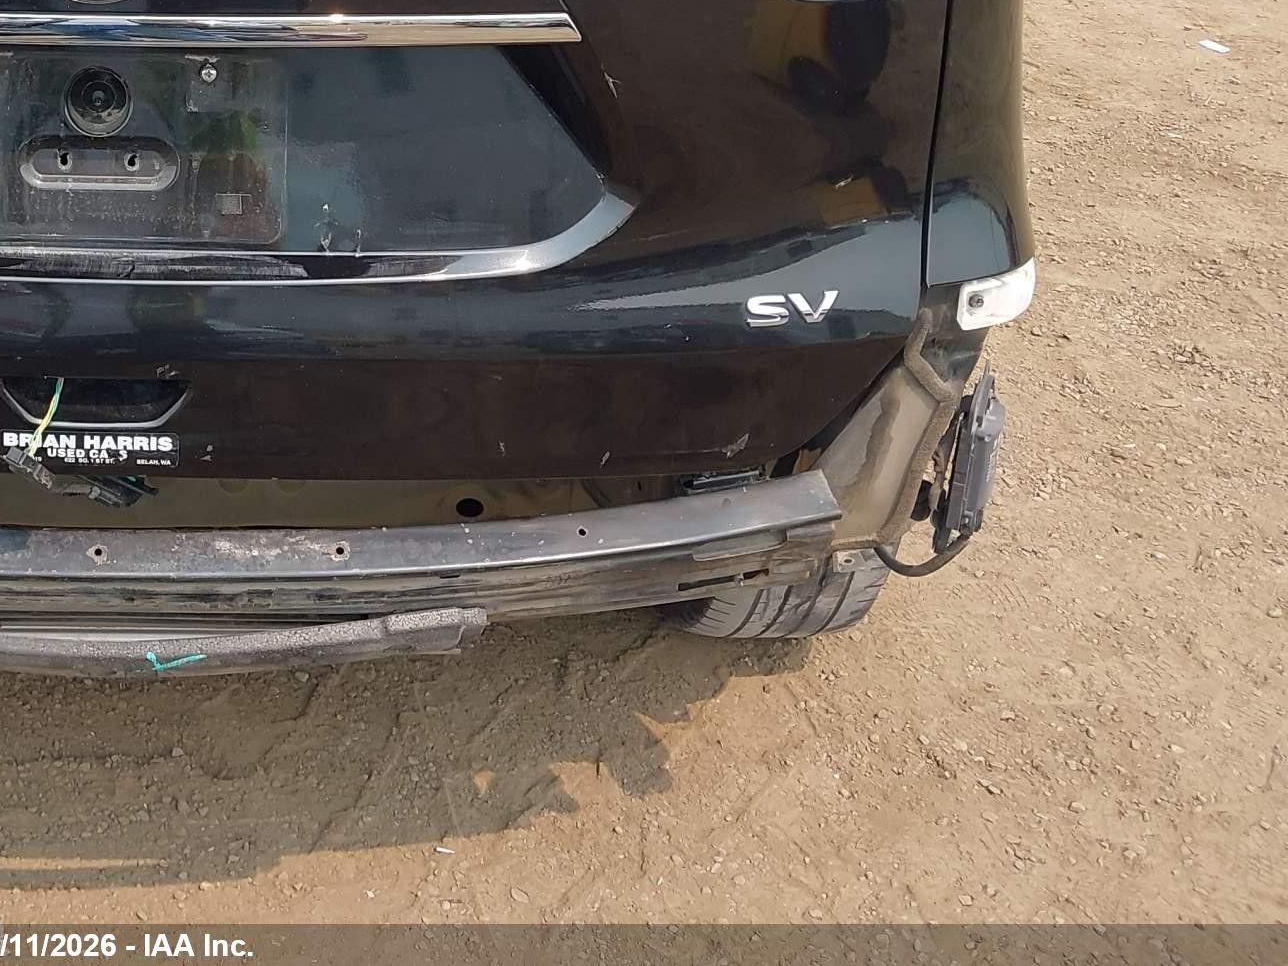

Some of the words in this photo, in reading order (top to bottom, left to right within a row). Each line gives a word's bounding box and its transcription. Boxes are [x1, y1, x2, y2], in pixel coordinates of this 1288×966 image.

[746, 290, 840, 328] SV
[83, 435, 173, 451] HARRIS
[47, 447, 86, 458] USED
[89, 449, 128, 461] CAS
